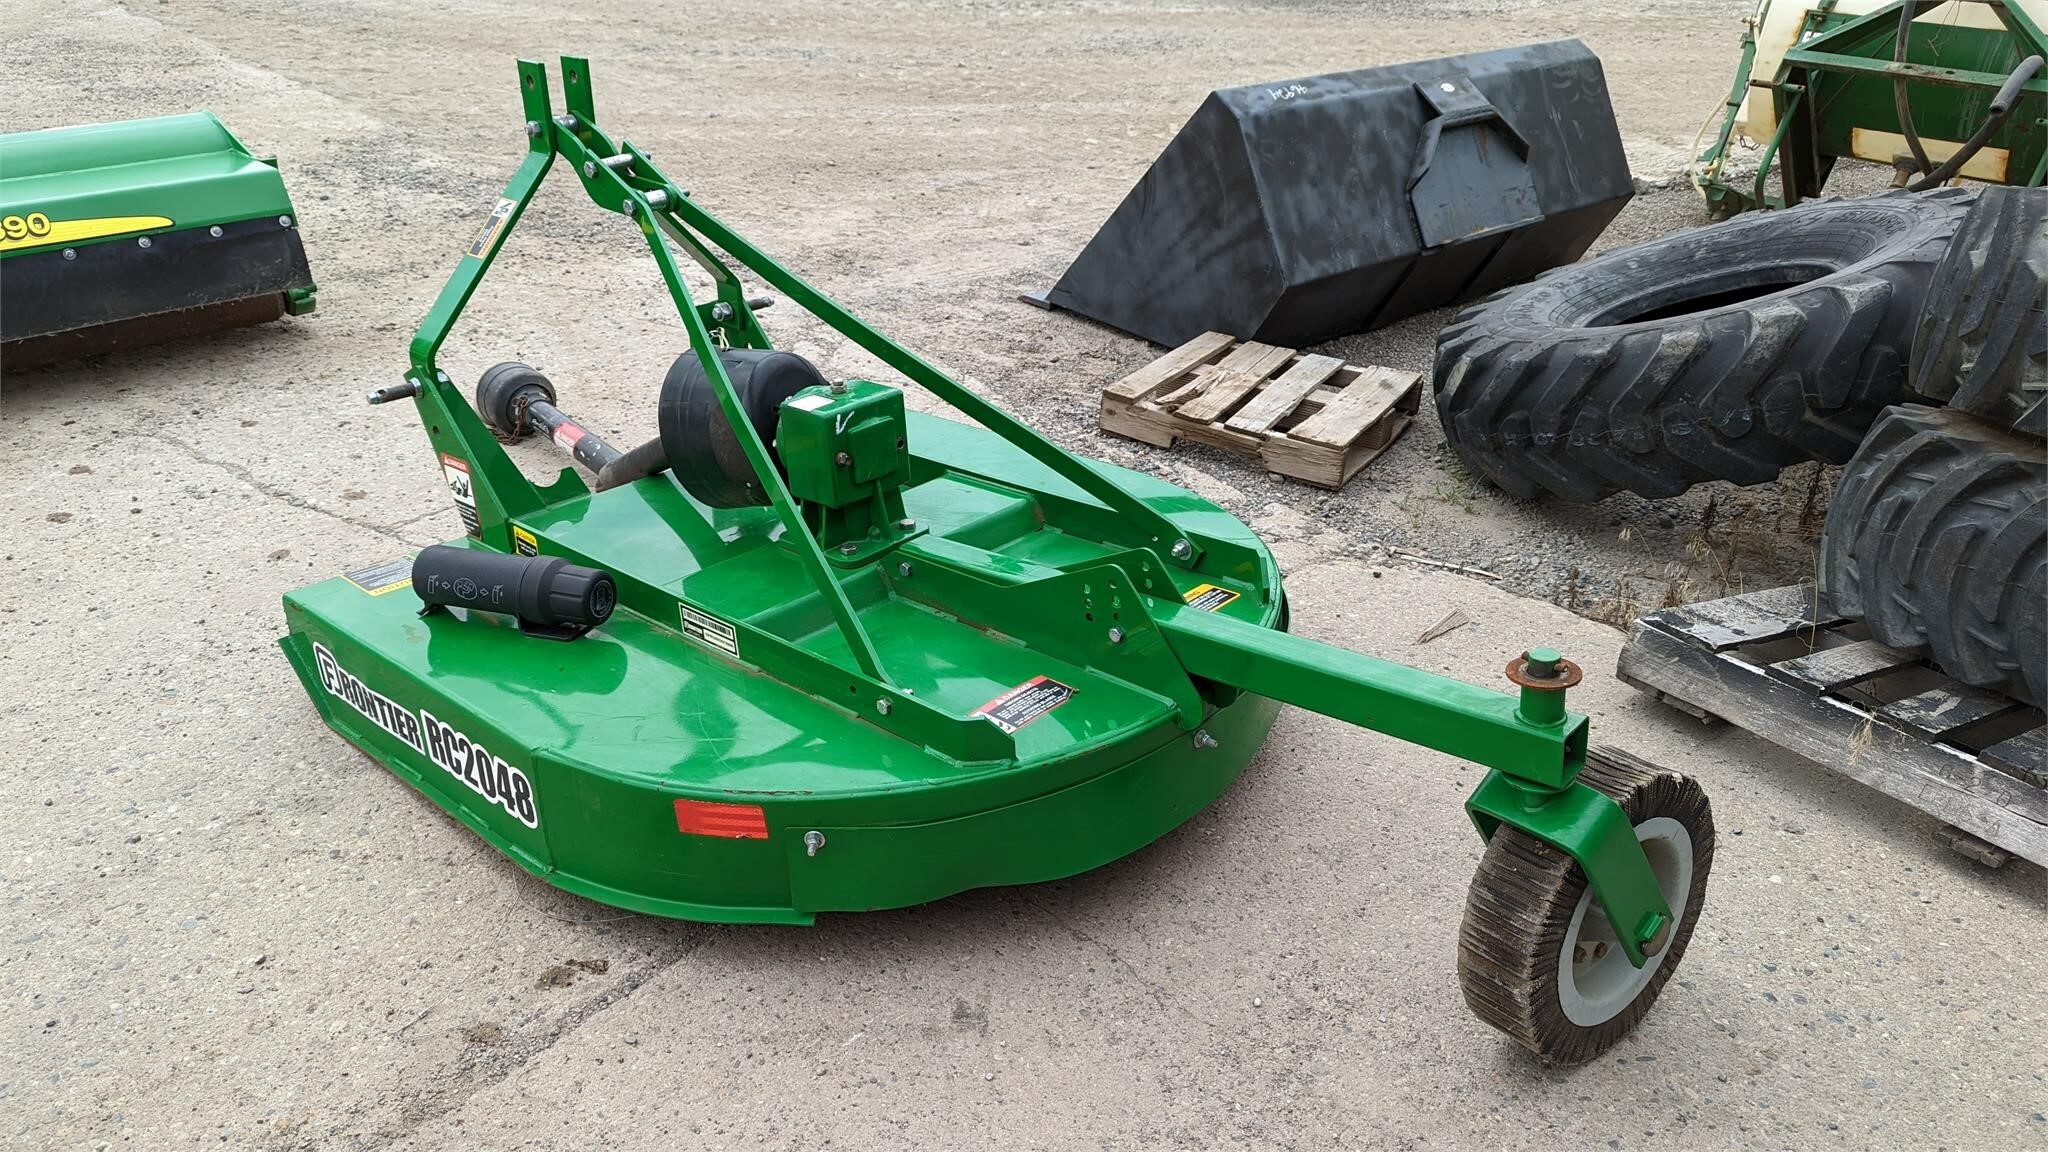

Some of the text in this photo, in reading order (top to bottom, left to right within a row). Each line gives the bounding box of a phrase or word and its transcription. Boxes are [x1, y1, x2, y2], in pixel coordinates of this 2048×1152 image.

[0, 212, 51, 242] 90
[315, 643, 536, 824] FRONTIER RC2048
